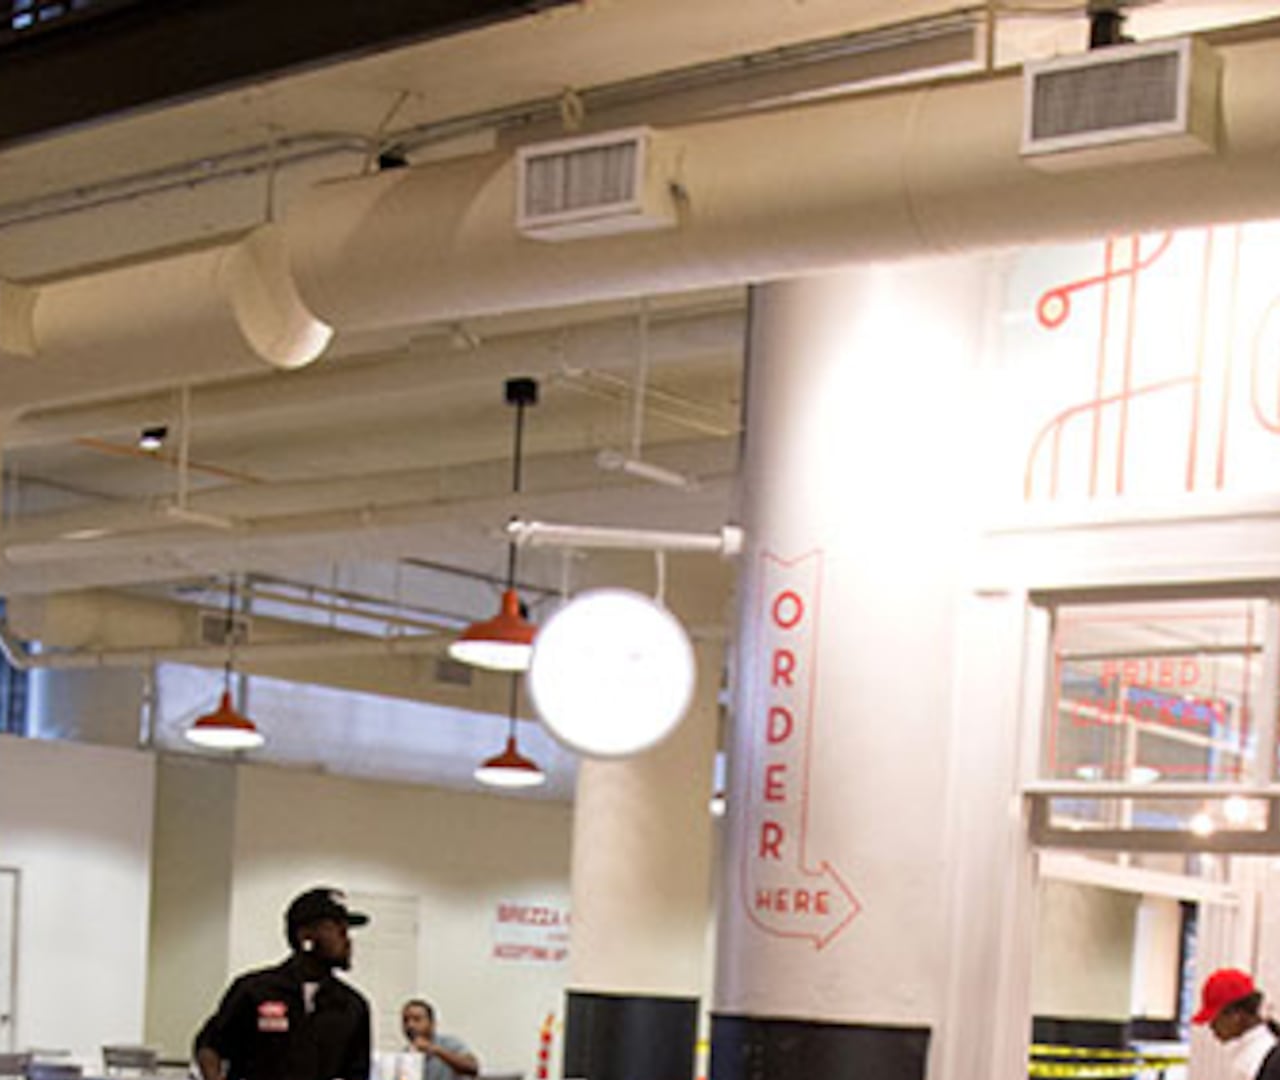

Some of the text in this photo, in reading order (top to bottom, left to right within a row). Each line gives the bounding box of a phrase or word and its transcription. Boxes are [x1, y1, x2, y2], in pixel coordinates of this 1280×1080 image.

[1101, 656, 1200, 689] FRIED
[758, 590, 804, 860] ORDER
[1071, 696, 1228, 727] CHICKEN
[755, 889, 830, 915] HERE
